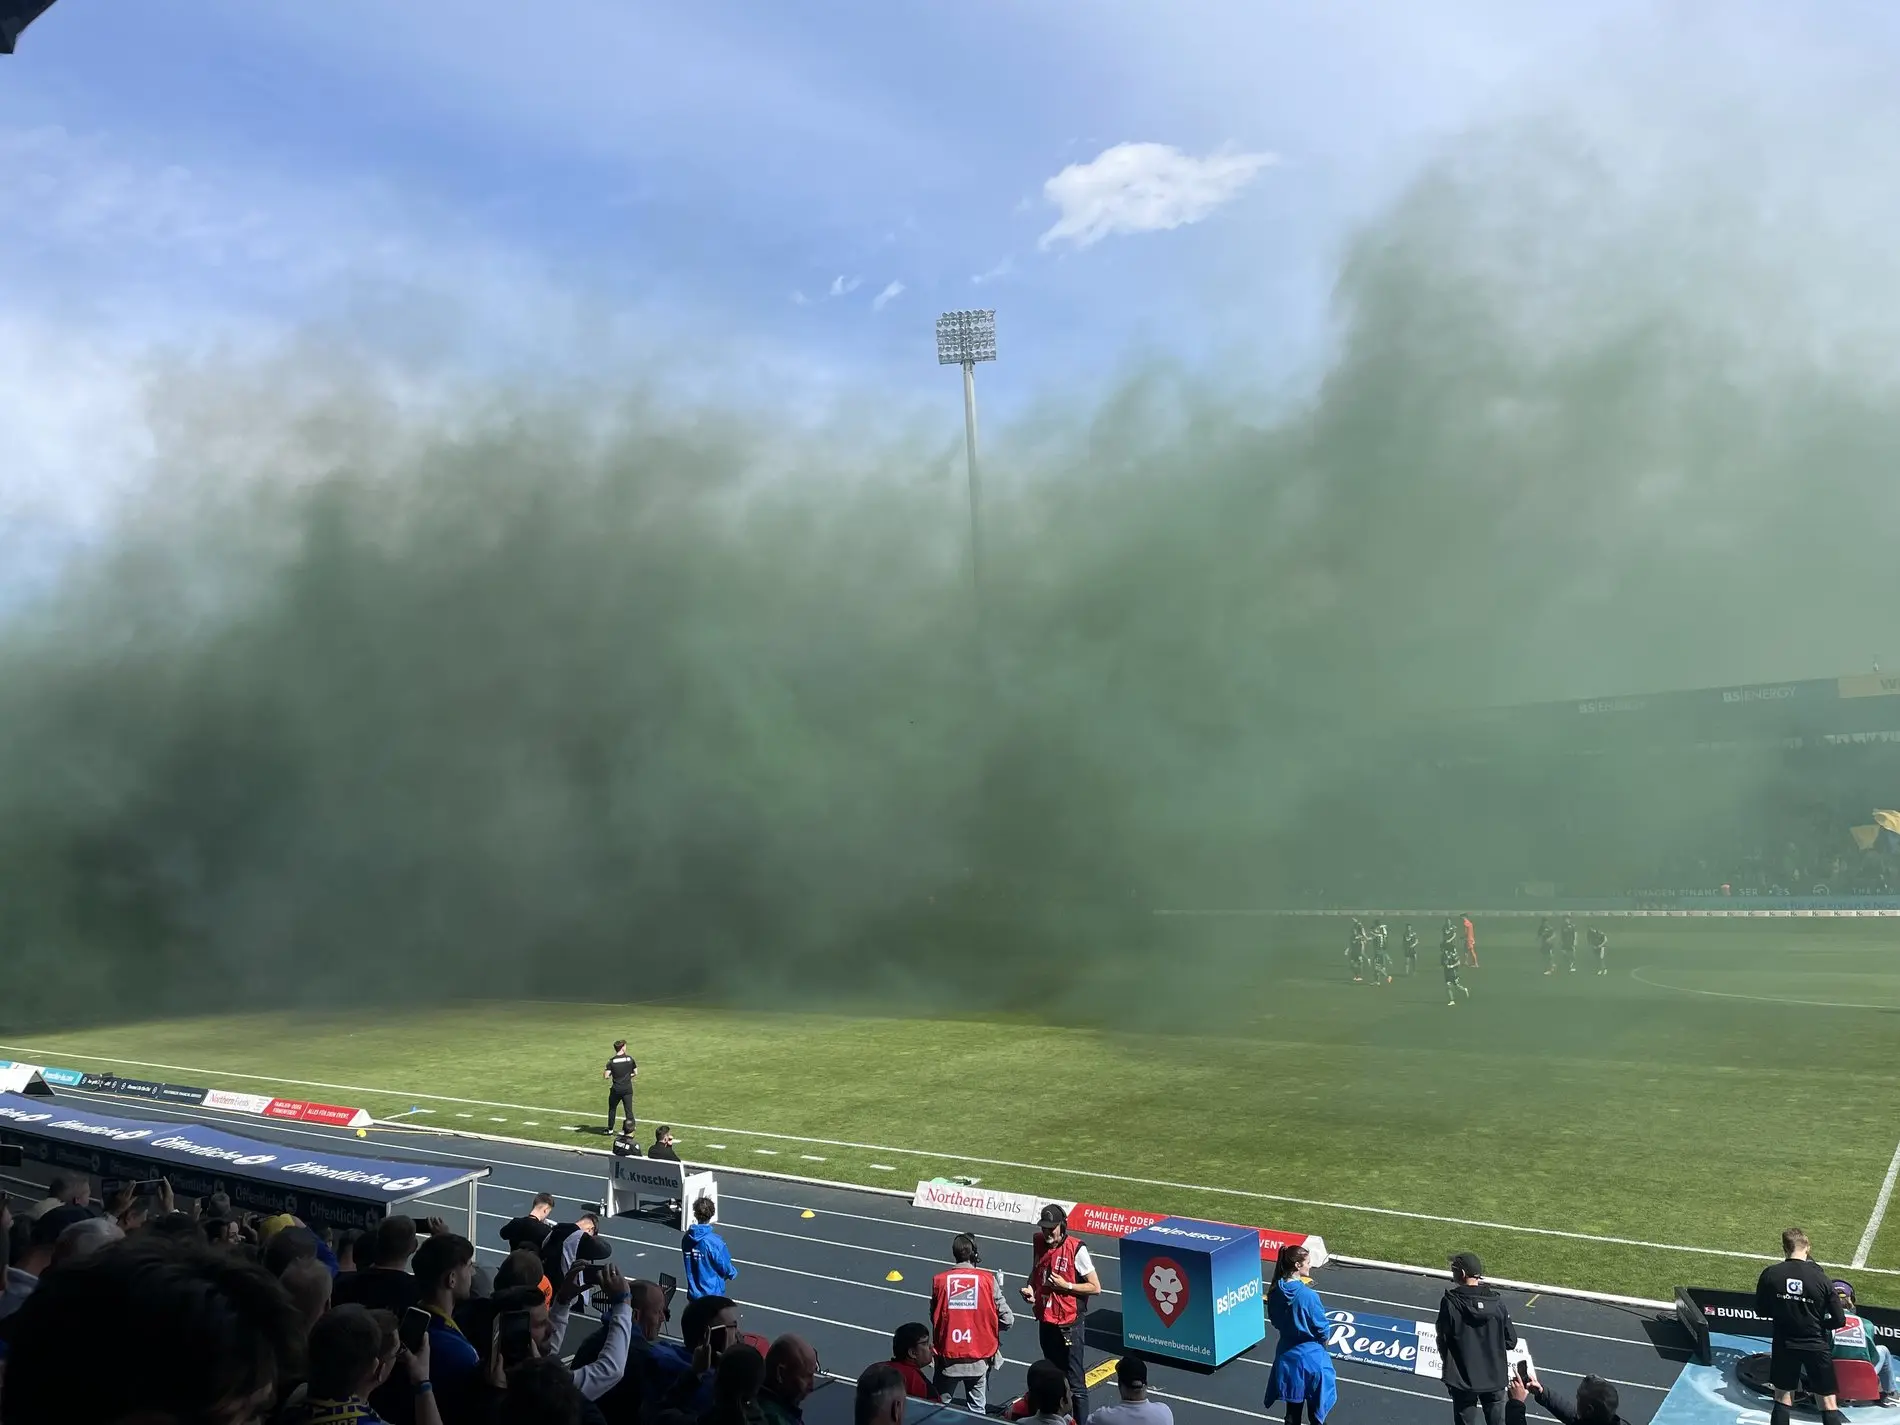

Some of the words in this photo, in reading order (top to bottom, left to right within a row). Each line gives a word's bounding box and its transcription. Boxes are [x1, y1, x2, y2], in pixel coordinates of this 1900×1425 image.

[151, 1136, 241, 1163] Öffentliche
[281, 1161, 388, 1189] Öffentliche
[629, 1172, 679, 1189] Kroschke
[235, 1183, 284, 1210] Öffentliche
[926, 1188, 984, 1209] Northern
[985, 1197, 1022, 1214] Events
[309, 1198, 363, 1225] Öffentliche
[1087, 1219, 1142, 1234] FIRMENFEIE
[1129, 1216, 1155, 1227] ODER
[1258, 1238, 1285, 1249] VENT
[966, 1289, 974, 1299] 2
[1717, 1307, 1774, 1321] BUNDE
[952, 1328, 972, 1343] 04
[1852, 1328, 1861, 1338] 2
[1874, 1326, 1900, 1339] NDE
[1128, 1332, 1211, 1356] www.loewenbuendel.de
[1327, 1324, 1416, 1360] Reese
[1428, 1360, 1443, 1370] dig
